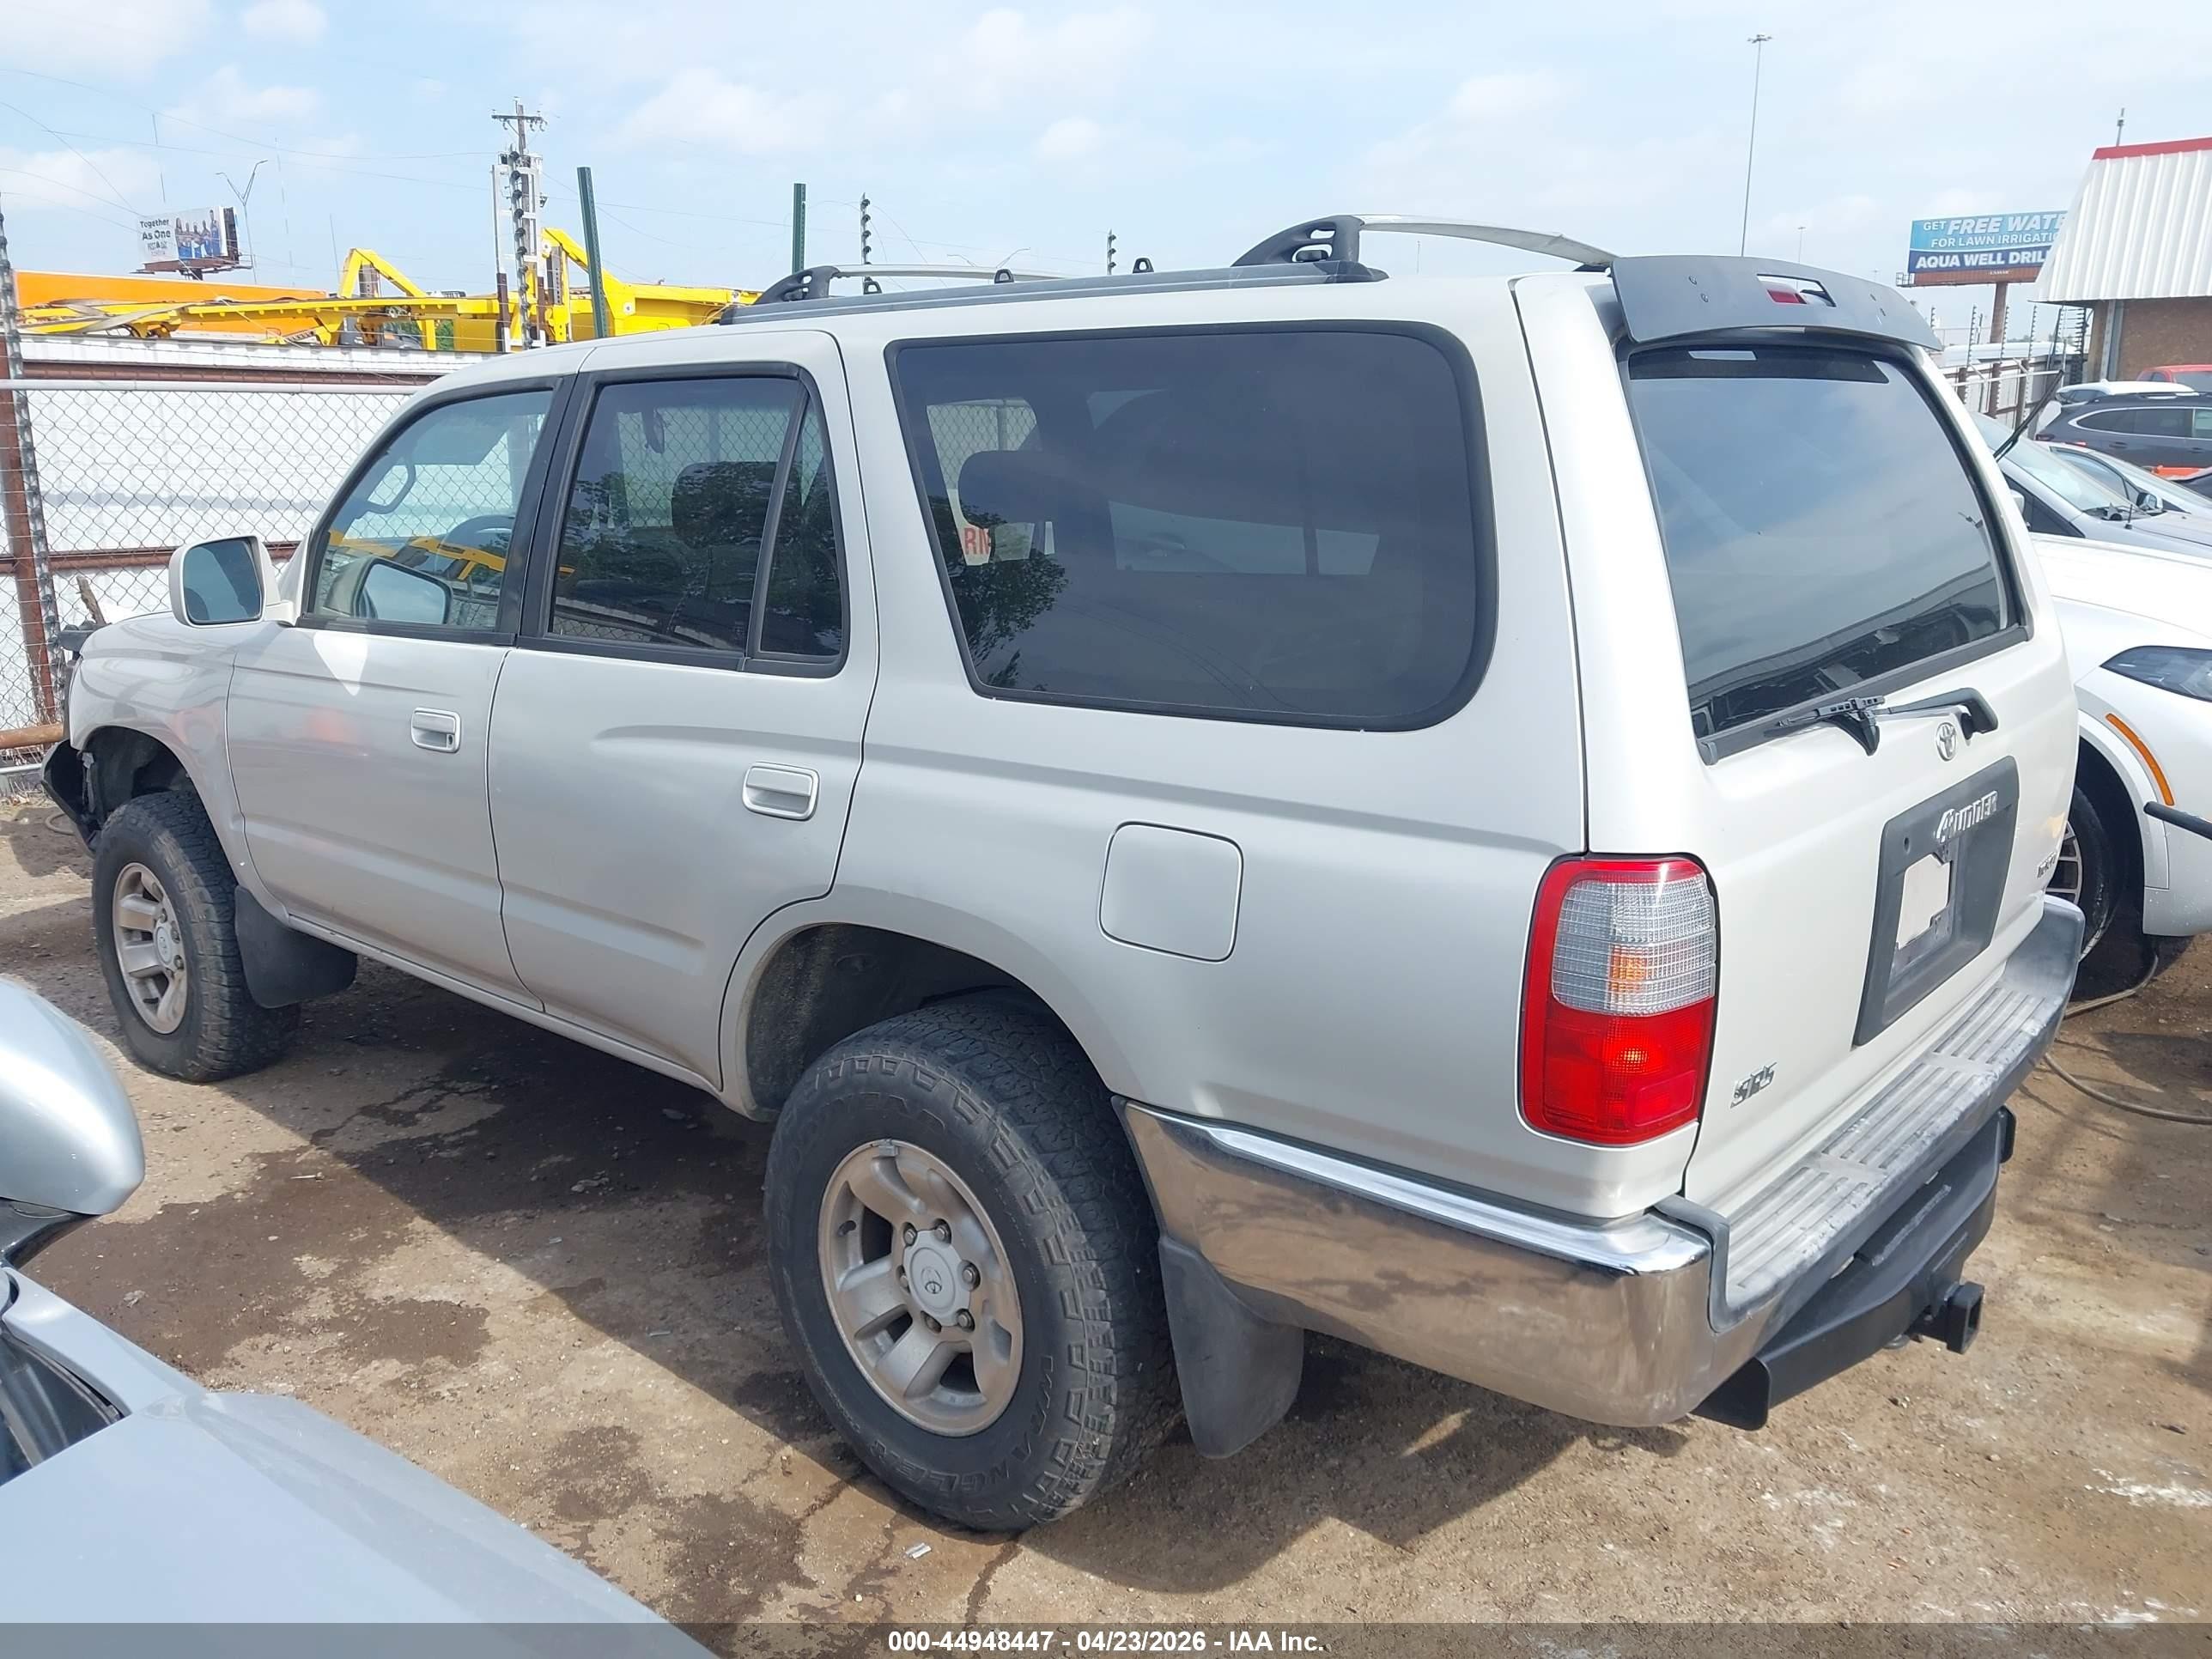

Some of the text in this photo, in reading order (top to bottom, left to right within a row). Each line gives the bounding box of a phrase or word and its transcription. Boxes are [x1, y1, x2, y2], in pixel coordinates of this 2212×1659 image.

[140, 219, 169, 228] Together
[1923, 221, 1947, 231] GET
[1947, 217, 2002, 235] FREE
[143, 230, 171, 240] As One
[1930, 237, 1955, 248] FOR
[1958, 234, 1995, 246] LAWN
[1915, 254, 1961, 269] AQUA
[1964, 252, 2005, 266] WELL
[1729, 1061, 1778, 1109] SR5
